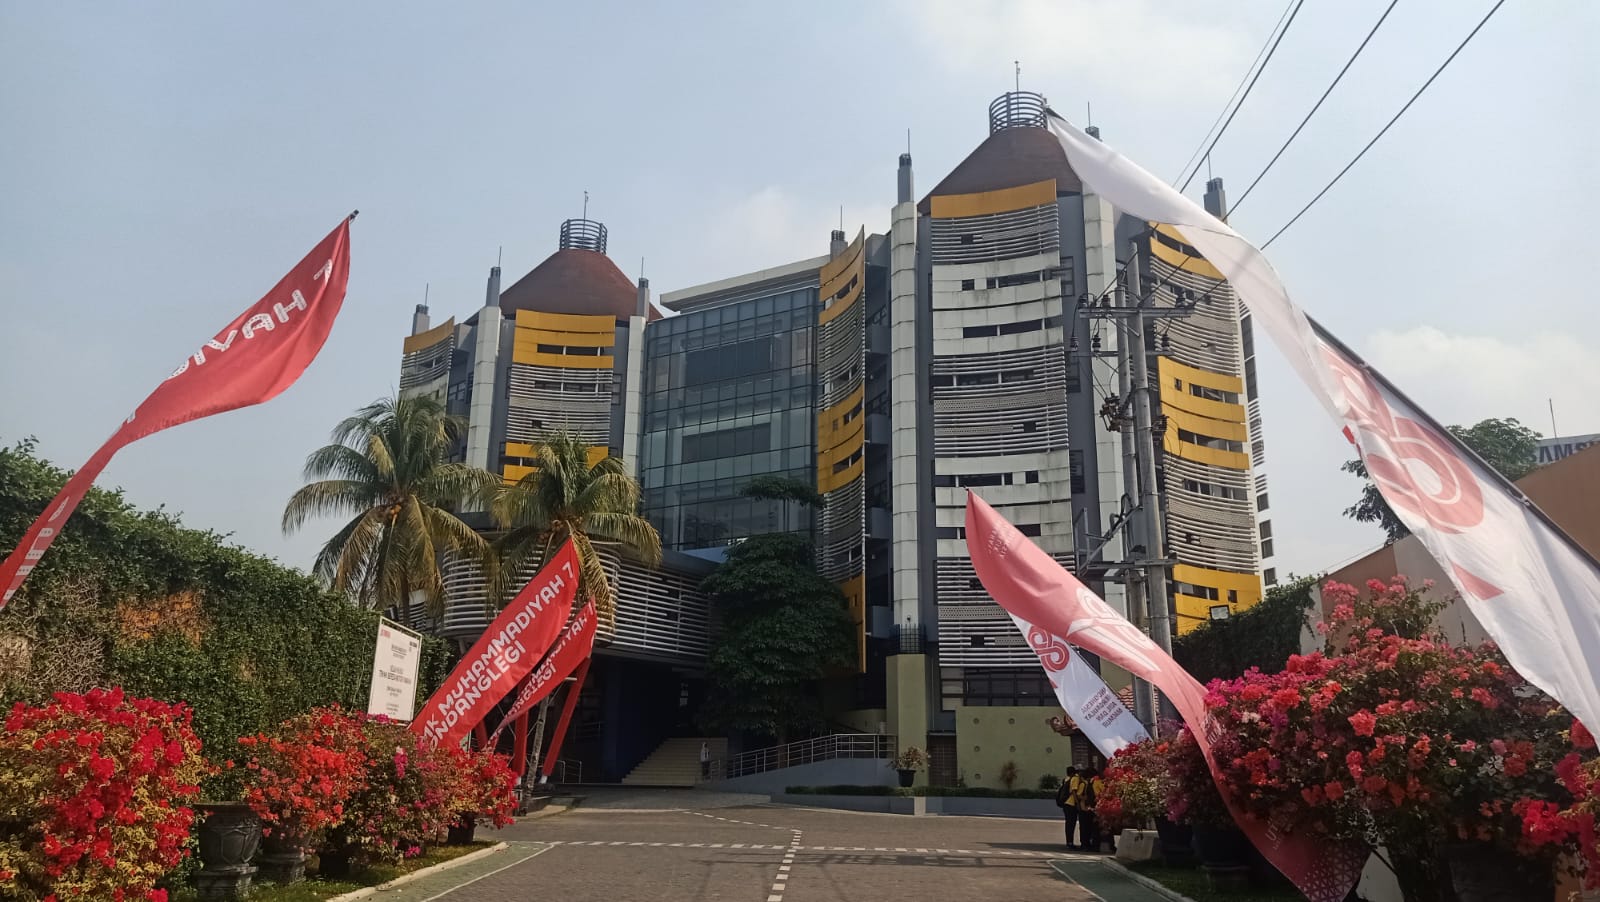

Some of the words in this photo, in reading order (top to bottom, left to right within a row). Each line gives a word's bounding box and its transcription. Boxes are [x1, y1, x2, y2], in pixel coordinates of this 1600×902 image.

[312, 258, 333, 288] 7
[419, 711, 440, 742] MK
[438, 574, 565, 717] MUHAMMADIYAH
[561, 561, 574, 579] 7
[429, 639, 527, 753] ONDANGLEGI
